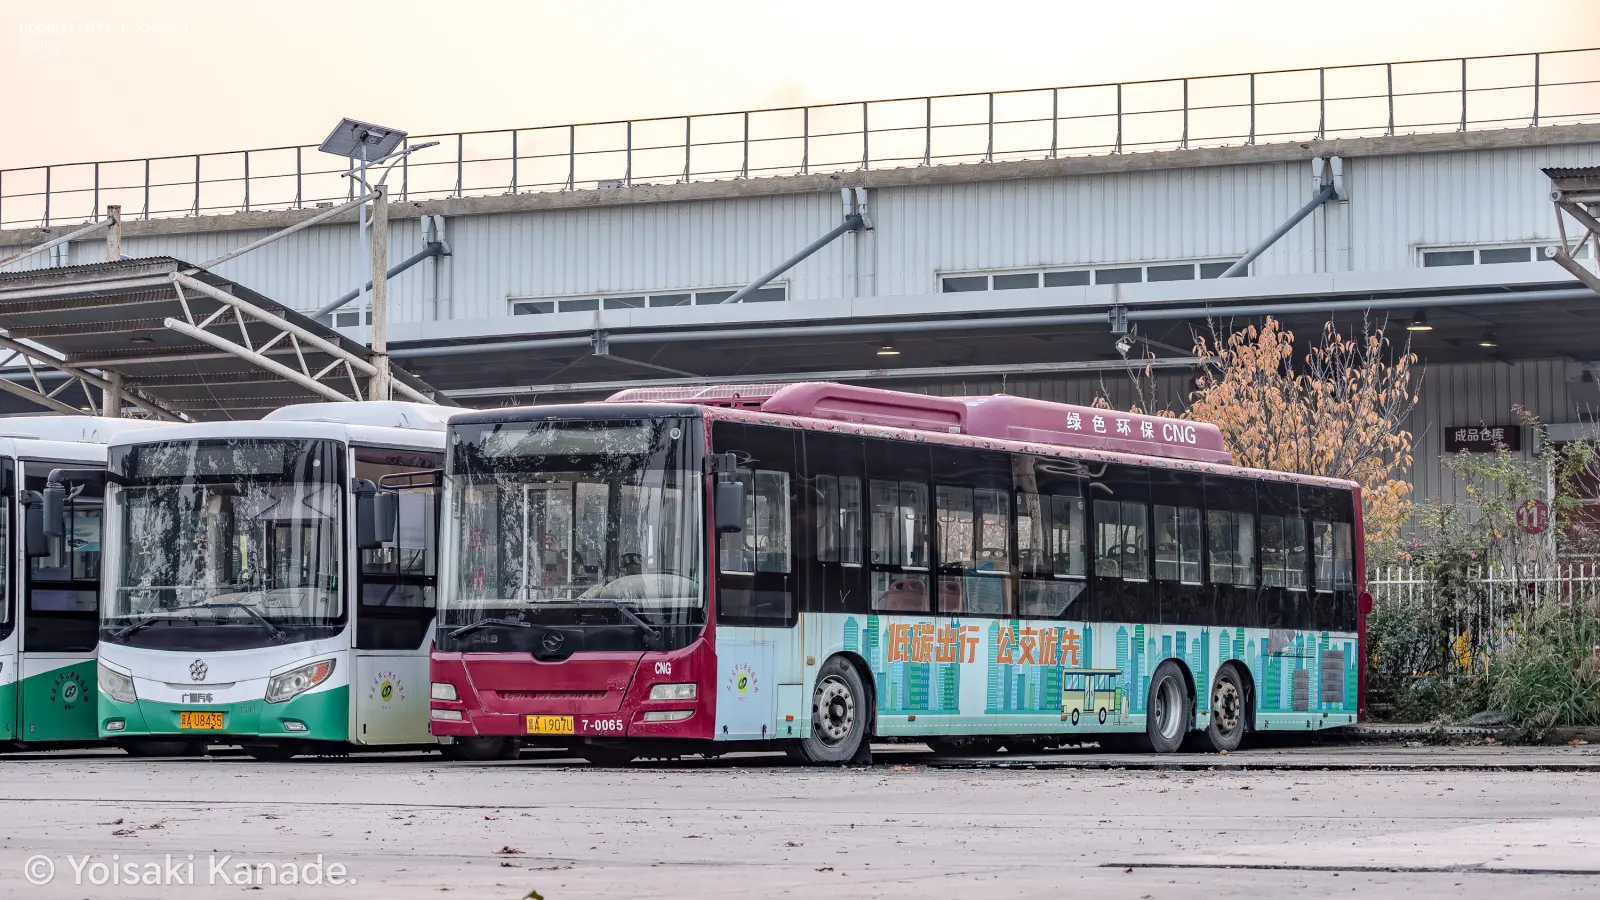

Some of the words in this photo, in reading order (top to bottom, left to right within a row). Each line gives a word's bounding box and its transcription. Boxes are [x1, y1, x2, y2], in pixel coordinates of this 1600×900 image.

[1066, 411, 1155, 439] 绿色环保
[1162, 423, 1197, 445] CNG
[1454, 428, 1505, 442] 成品仓库
[887, 622, 980, 664] 低碳出行
[995, 626, 1081, 666] 公交优先
[654, 661, 672, 675] CNG
[194, 713, 222, 727] U8435
[581, 719, 623, 731] 7-0065
